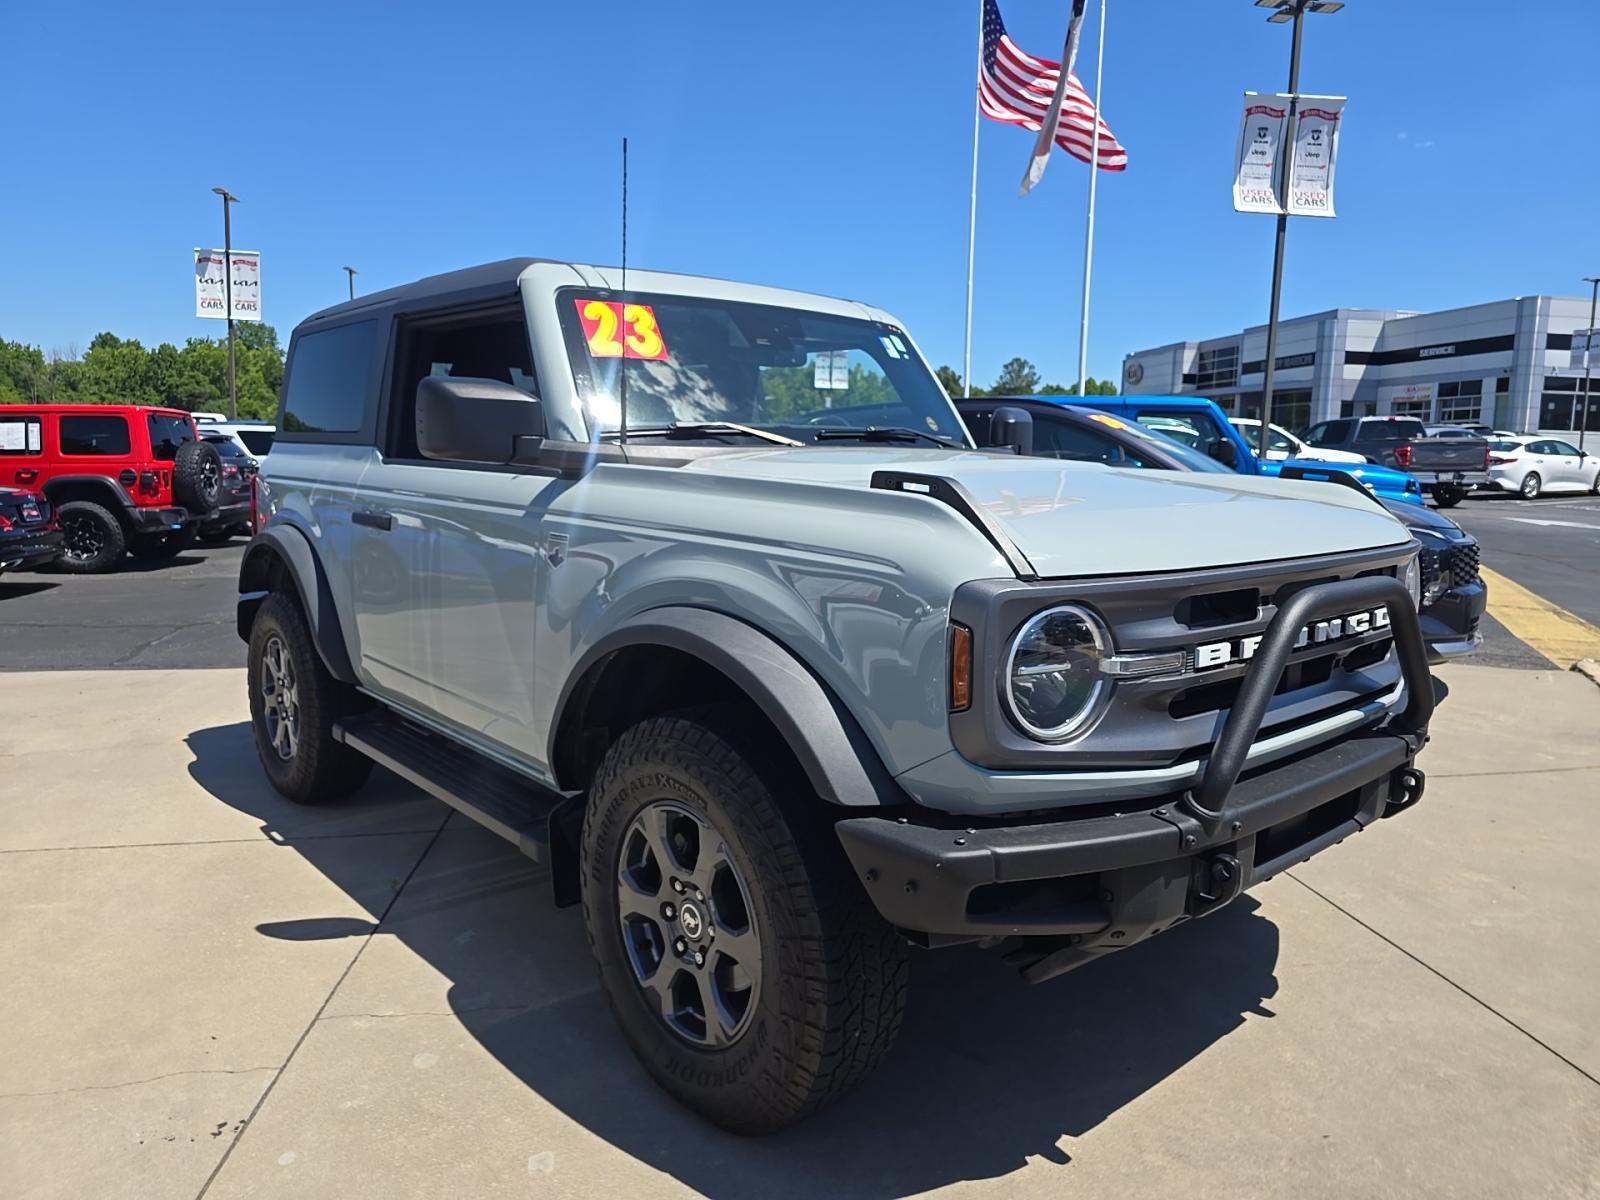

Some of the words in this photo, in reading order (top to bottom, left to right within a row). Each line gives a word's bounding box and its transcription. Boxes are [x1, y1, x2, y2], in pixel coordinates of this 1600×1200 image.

[1251, 149, 1267, 157] Jeep
[1305, 151, 1320, 159] Jeep
[1241, 188, 1272, 197] USED
[1294, 191, 1325, 200] USED
[1243, 195, 1273, 204] CARS
[1295, 199, 1325, 207] CARS
[200, 301, 224, 310] CARS
[234, 303, 258, 311] CARS
[583, 300, 662, 358] 23
[1419, 345, 1456, 358] SERVICE
